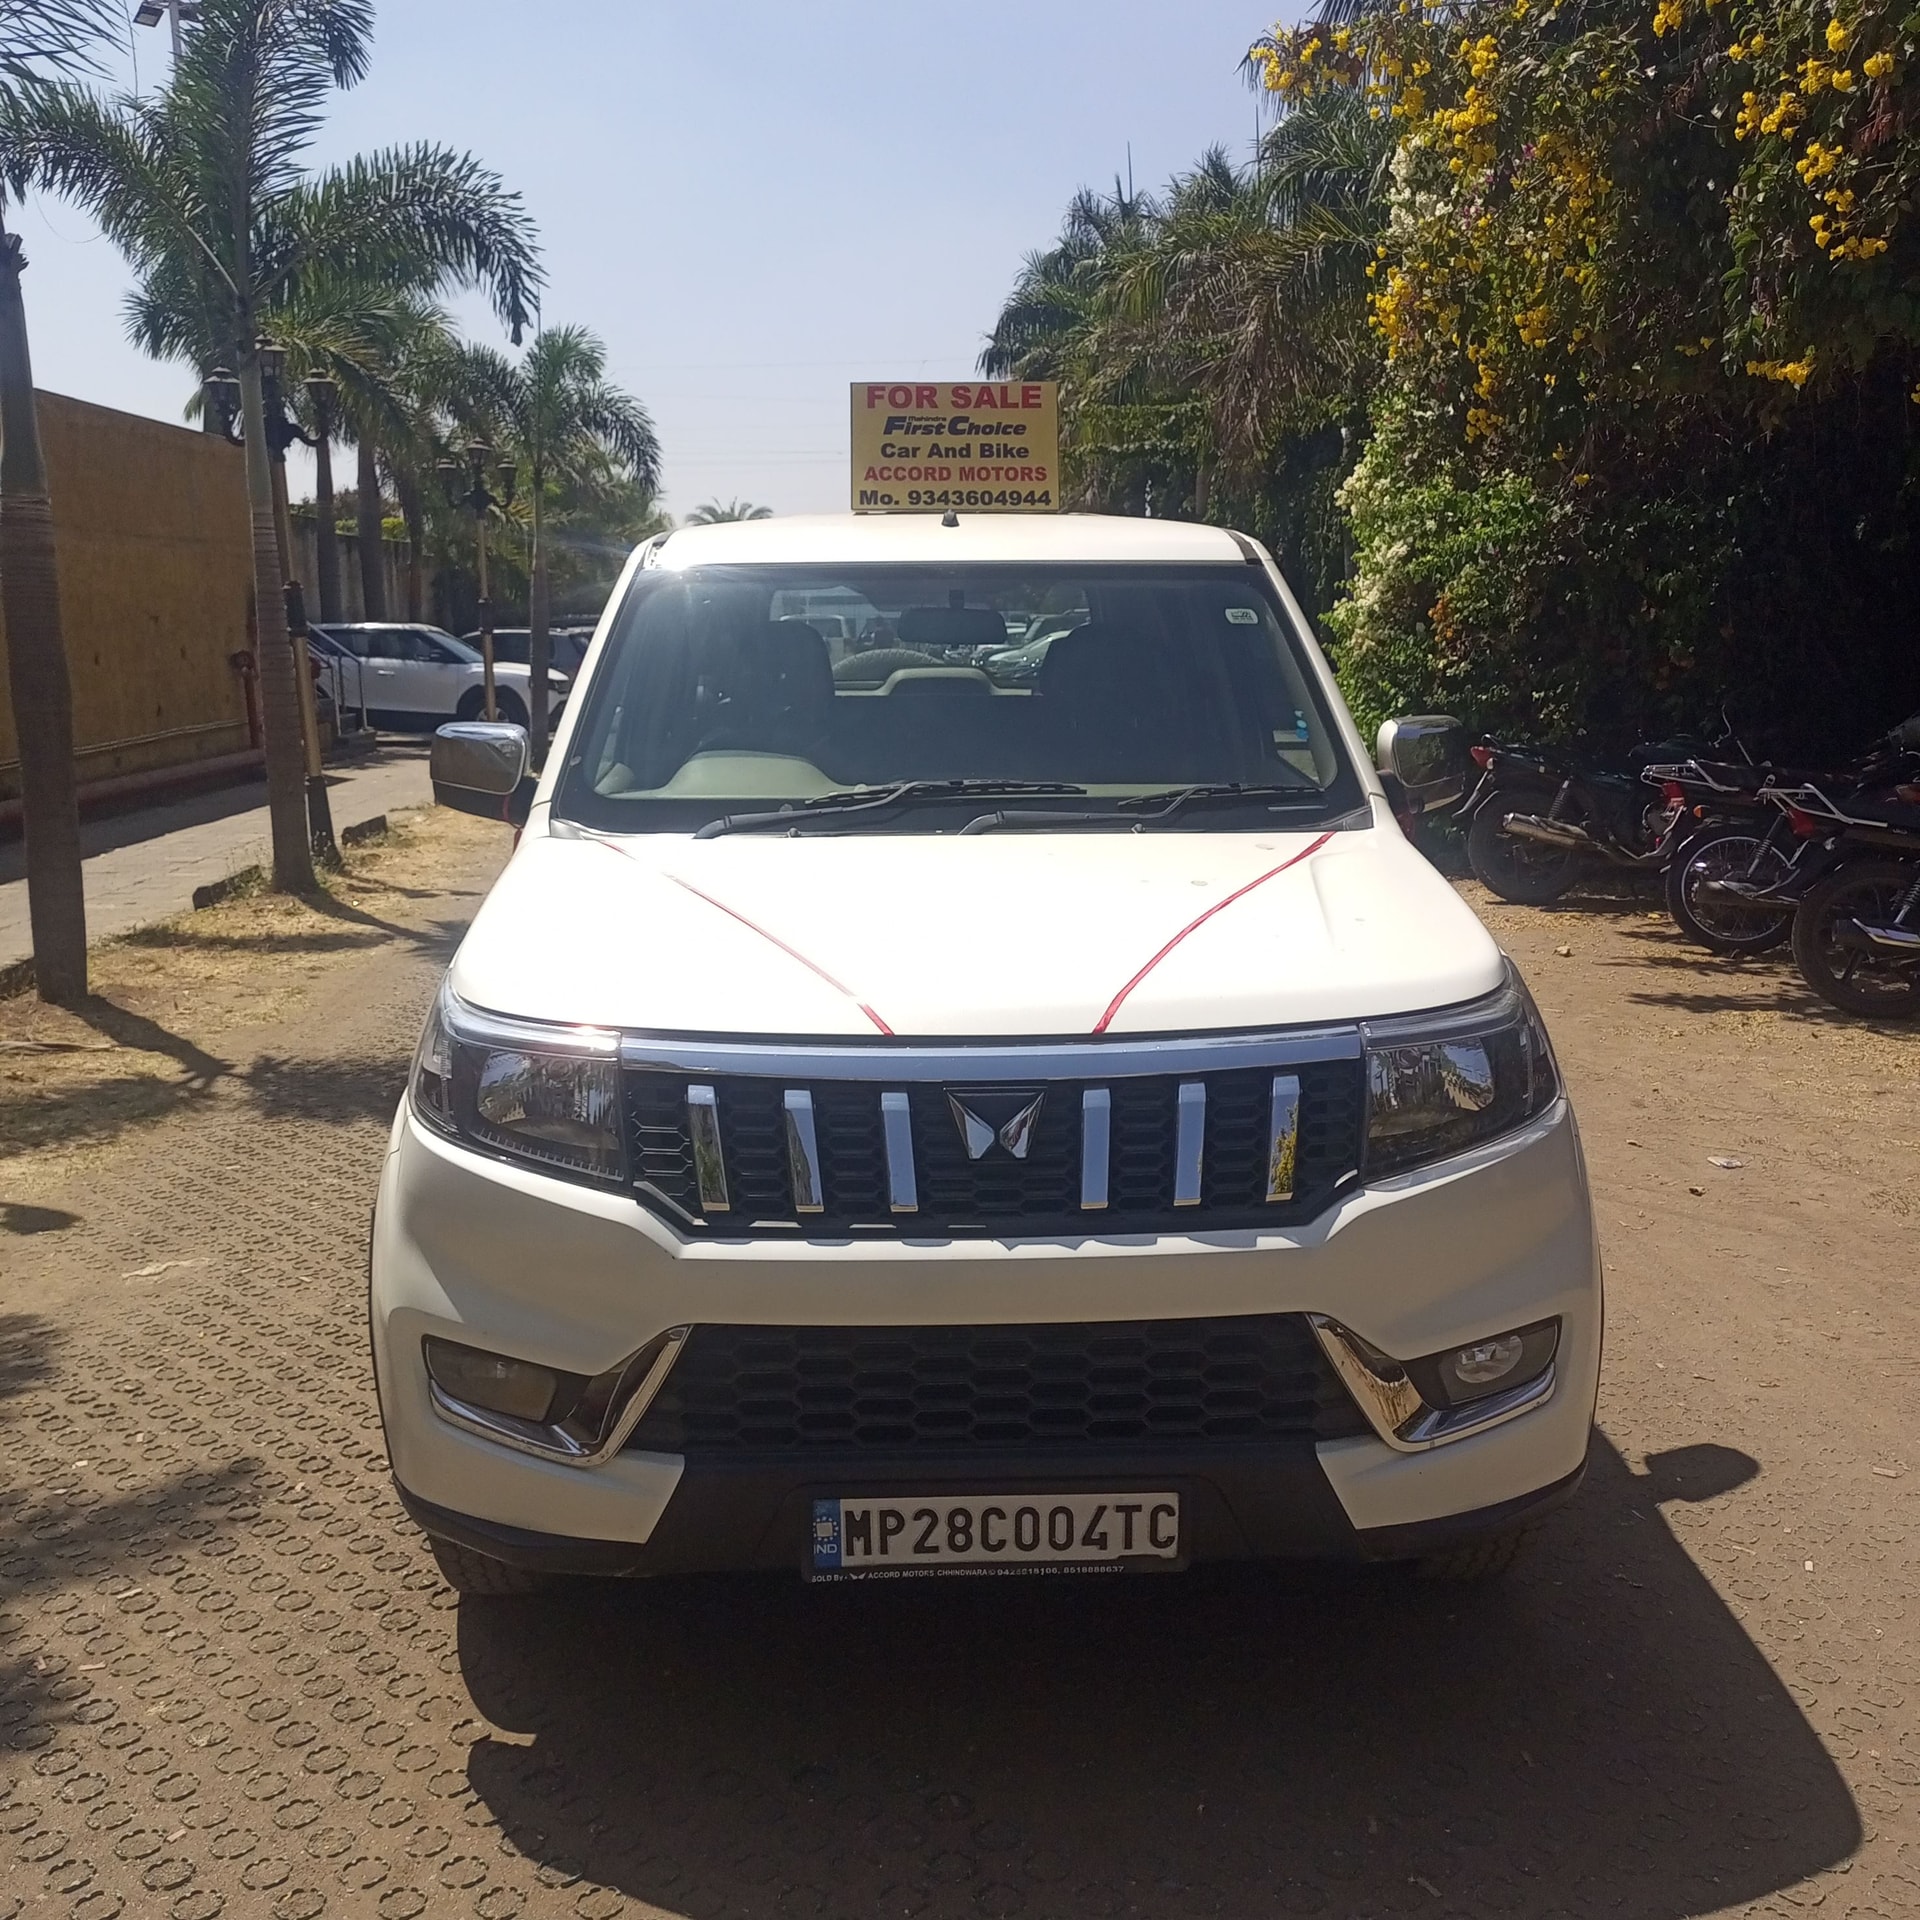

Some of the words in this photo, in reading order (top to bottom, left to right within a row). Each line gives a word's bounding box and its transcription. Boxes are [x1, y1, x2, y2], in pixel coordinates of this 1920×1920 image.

[866, 385, 938, 409] FOR
[951, 385, 1042, 409] SALE
[880, 443, 920, 459] Car
[927, 443, 971, 458] And
[979, 443, 1030, 458] Bike
[864, 466, 951, 481] ACCORD
[959, 466, 1047, 481] MOTORS
[859, 490, 900, 506] Mo.
[908, 490, 1051, 506] 9343604944
[845, 1504, 1176, 1557] MP28C004TC
[813, 1544, 838, 1555] IND
[868, 1571, 900, 1579] ACCORD
[902, 1569, 934, 1578] MOTORS
[937, 1568, 987, 1577] CHHINDWARA
